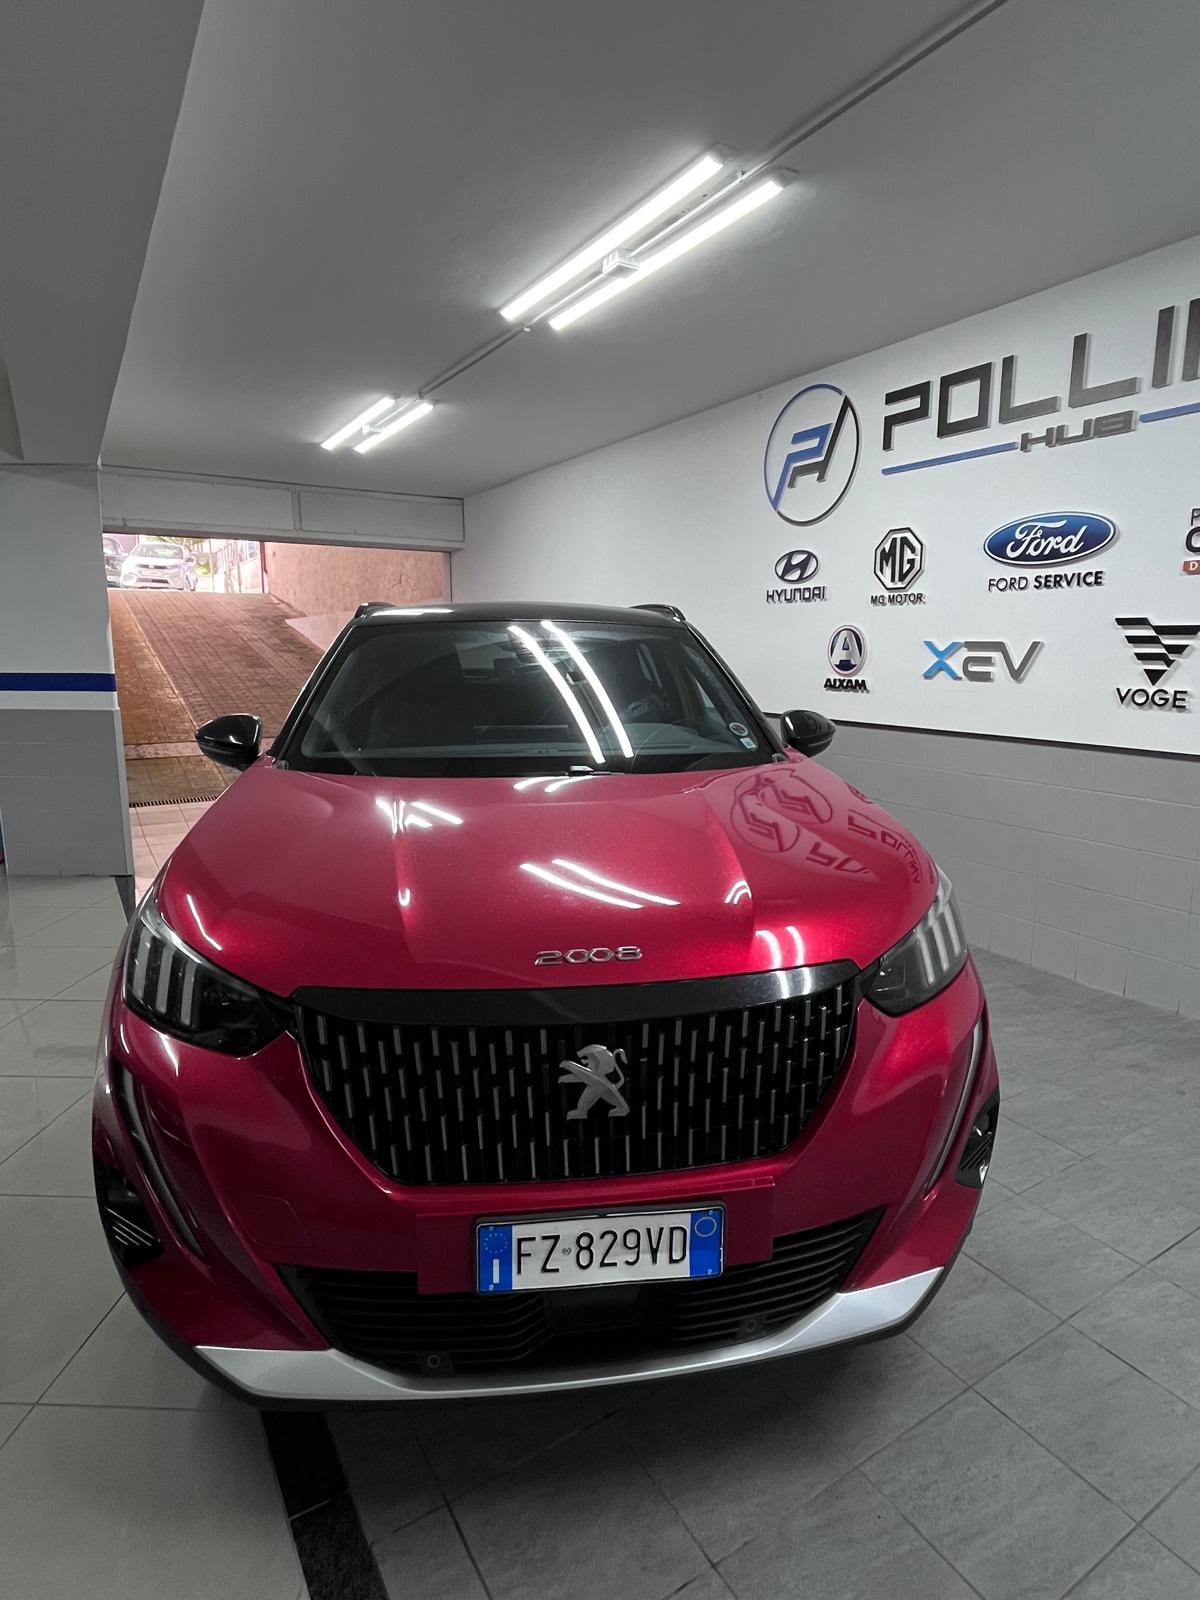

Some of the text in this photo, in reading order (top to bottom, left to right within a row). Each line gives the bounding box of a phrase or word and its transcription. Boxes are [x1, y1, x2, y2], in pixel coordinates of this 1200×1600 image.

[882, 297, 1200, 452] POLLI
[1020, 410, 1138, 452] HUB
[1005, 520, 1084, 557] Ford
[879, 536, 916, 583] MG
[766, 586, 827, 603] HYUNDAI
[988, 571, 1104, 592] FORD SERVICE
[870, 592, 925, 606] MG MOTOR
[921, 640, 1044, 682] XEV
[823, 677, 869, 692] AIXAM
[1116, 687, 1190, 710] VOGE
[534, 945, 643, 966] 2008
[516, 1234, 561, 1275] FZ
[575, 1225, 688, 1270] 829VD
